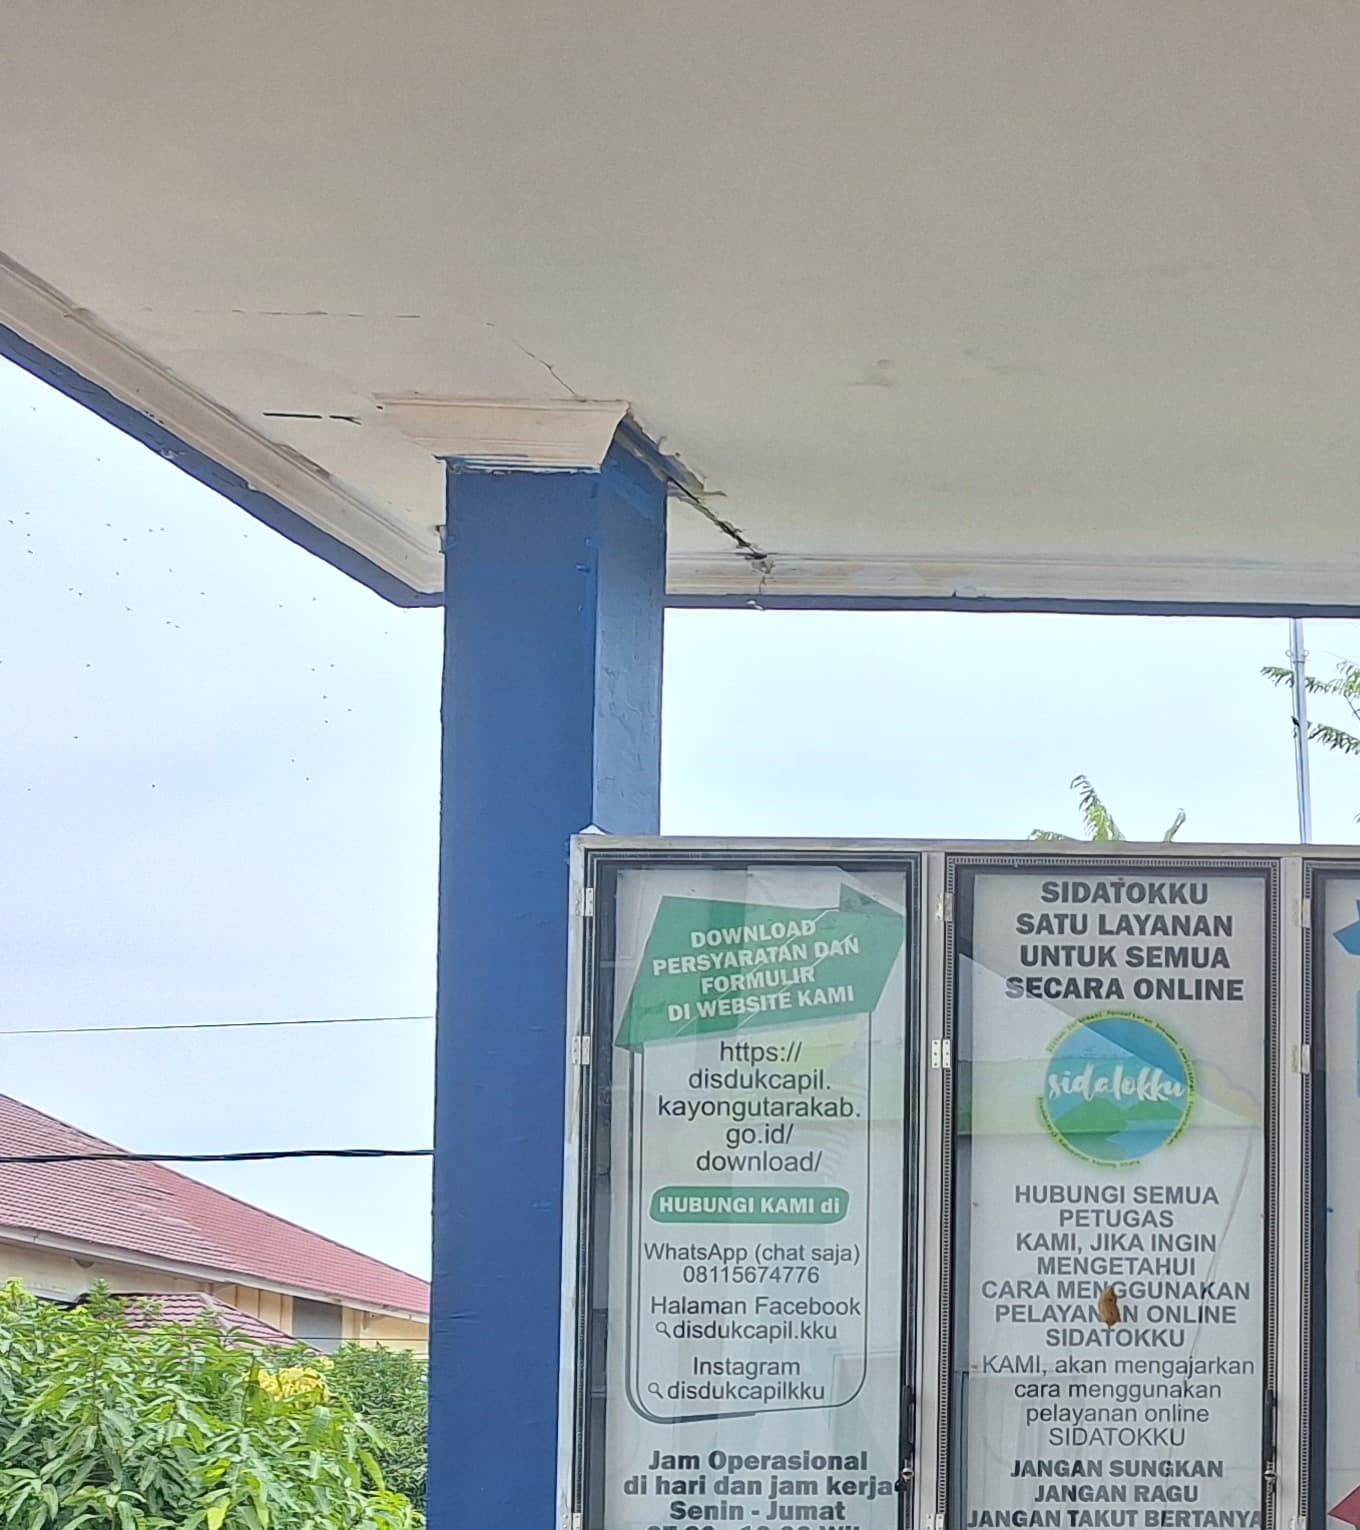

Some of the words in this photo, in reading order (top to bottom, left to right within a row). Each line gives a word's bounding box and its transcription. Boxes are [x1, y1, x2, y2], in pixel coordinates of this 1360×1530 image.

[1040, 881, 1208, 905] SIDATOKKU
[690, 919, 816, 948] DOWNLOAD
[1015, 913, 1088, 936] SATU
[1100, 914, 1233, 937] LAYANAN
[652, 944, 808, 976] PERSYARATAN
[813, 937, 860, 959] DAN
[701, 966, 816, 994] FORMULIR
[1005, 977, 1125, 1000] SECARA
[1133, 979, 1244, 1001] ONLINE
[668, 1004, 690, 1022] DI
[695, 993, 792, 1018] WEBSITE
[797, 986, 855, 1008] KAMI
[720, 1041, 802, 1066] https://
[688, 1068, 831, 1094] disdukcapil.
[657, 1095, 861, 1121] kayongutarakab.
[725, 1123, 794, 1149] go.id/
[696, 1151, 823, 1172] download/
[1015, 1185, 1126, 1204] HUBUNGI
[1132, 1186, 1220, 1205] SEMUA
[1059, 1209, 1174, 1228] PETUGAS
[643, 1243, 748, 1266] WhatsApp
[754, 1243, 805, 1266] (chat
[811, 1243, 861, 1266] saja)
[1037, 1257, 1196, 1276] MENGETAHUI
[683, 1266, 820, 1284] 08115674776
[651, 1295, 747, 1315] Halaman
[755, 1295, 861, 1316] Facebook
[995, 1304, 1138, 1324] PELAYANN
[672, 1320, 838, 1344] disdukcapil.kku
[693, 1356, 801, 1380] Instagram
[982, 1355, 1046, 1376] KAMI,
[1054, 1356, 1107, 1375] akan
[1114, 1356, 1255, 1380] mengajarkan
[667, 1381, 825, 1405] disdukcapilkku
[648, 1450, 700, 1471] Jam
[708, 1450, 868, 1474] Operasional
[1010, 1459, 1103, 1478] JANGAN
[1109, 1460, 1223, 1478] SUNGKAN
[623, 1475, 647, 1496] di
[655, 1475, 707, 1496] hari
[713, 1475, 762, 1496] dan
[768, 1475, 819, 1500] jam
[826, 1475, 894, 1500] kerja
[669, 1501, 746, 1521] Senin
[766, 1501, 845, 1521] Jumat
